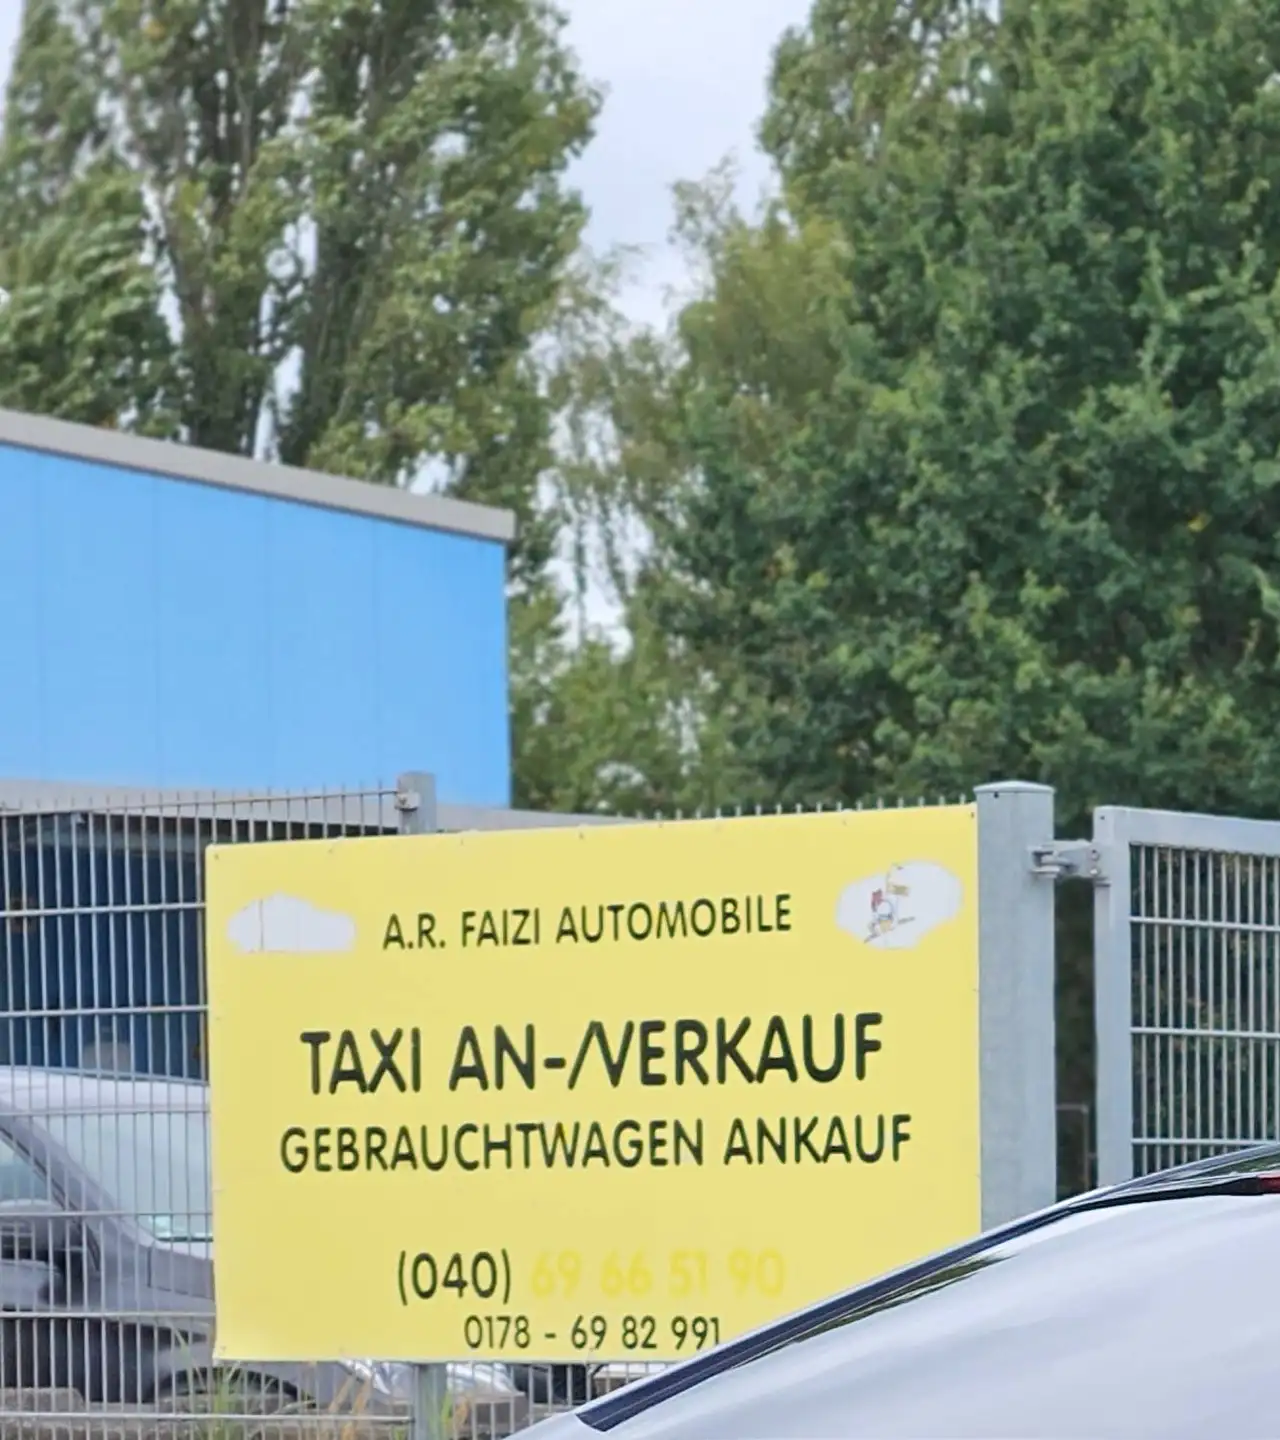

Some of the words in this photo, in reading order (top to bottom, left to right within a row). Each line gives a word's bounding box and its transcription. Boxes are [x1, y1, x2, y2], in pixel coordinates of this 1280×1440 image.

[383, 913, 446, 950] A.R.
[462, 908, 540, 947] FAIZI
[556, 893, 792, 944] AUTOMOBILE
[299, 1027, 421, 1095] TAXI
[449, 1012, 883, 1092] AN-/VERKAUF
[280, 1118, 703, 1174] GEBRAUCHTWAGEN
[723, 1114, 912, 1166] ANKAUF
[398, 1249, 511, 1306] (040)
[531, 1250, 581, 1297] 69
[601, 1250, 653, 1297] 66
[729, 1248, 784, 1297] 90
[464, 1315, 530, 1349] 0178
[571, 1315, 607, 1350] 69
[622, 1315, 657, 1350] 82
[671, 1315, 719, 1350] 991
